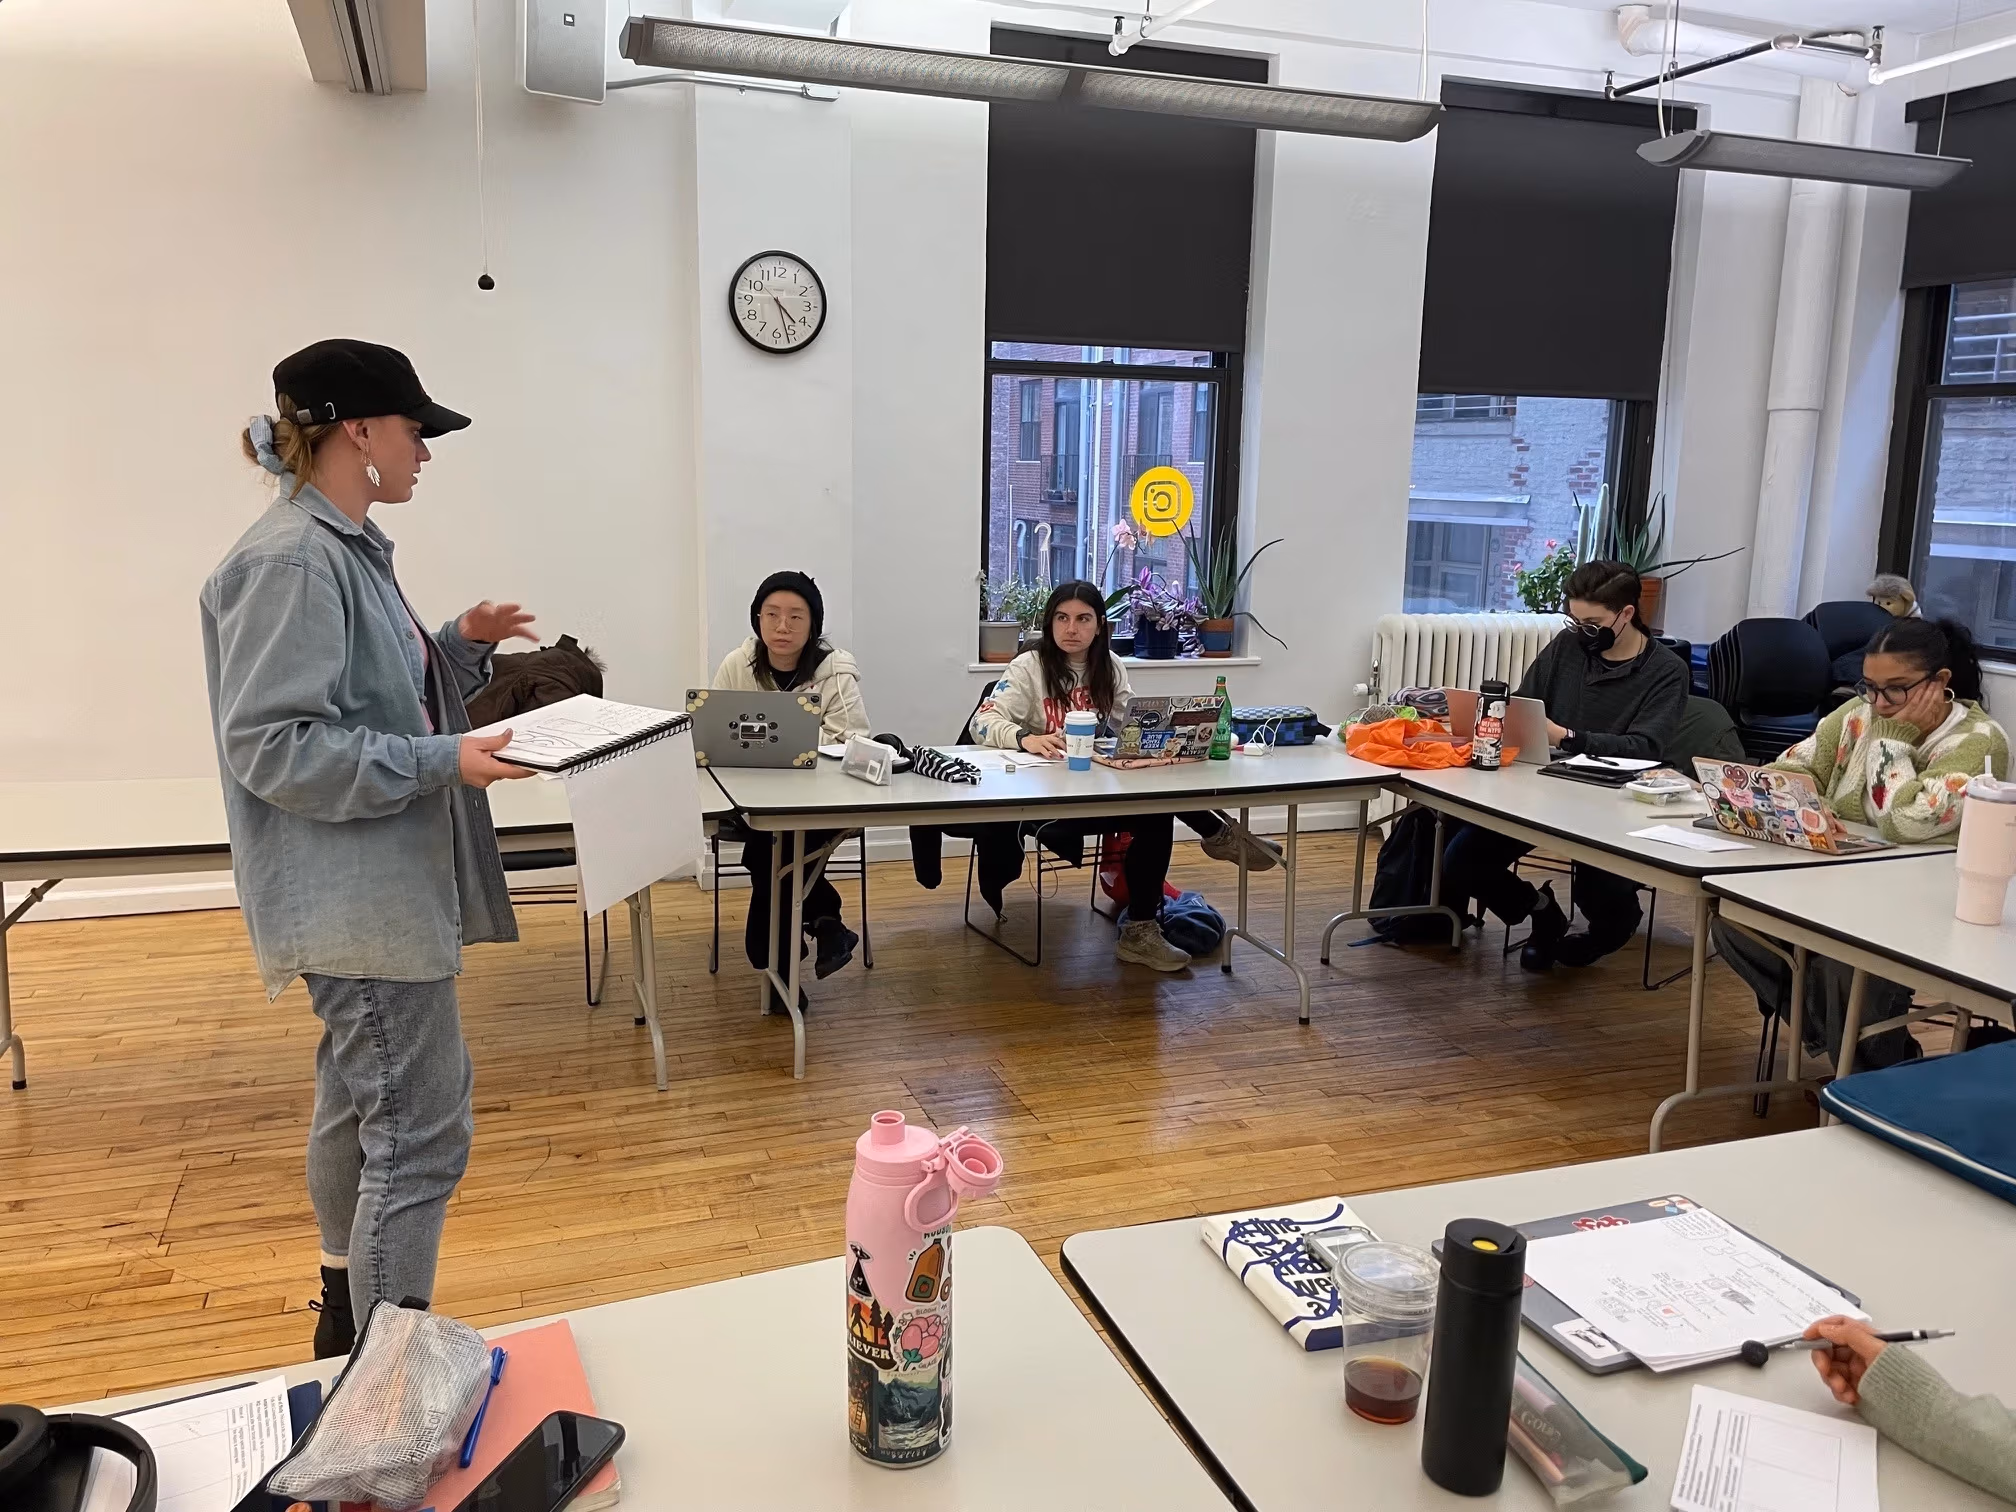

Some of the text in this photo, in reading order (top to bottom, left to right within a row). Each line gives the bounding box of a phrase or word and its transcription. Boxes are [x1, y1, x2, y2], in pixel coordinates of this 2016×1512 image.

[761, 269, 770, 281] 11
[773, 266, 787, 278] 12
[748, 280, 764, 291] 10
[798, 285, 808, 297] 2
[744, 294, 754, 305] 9
[802, 301, 812, 312] 3
[747, 309, 757, 321] 8
[758, 321, 767, 332] 7
[798, 316, 807, 326] 4
[772, 328, 782, 339] 6
[787, 324, 796, 336] 5
